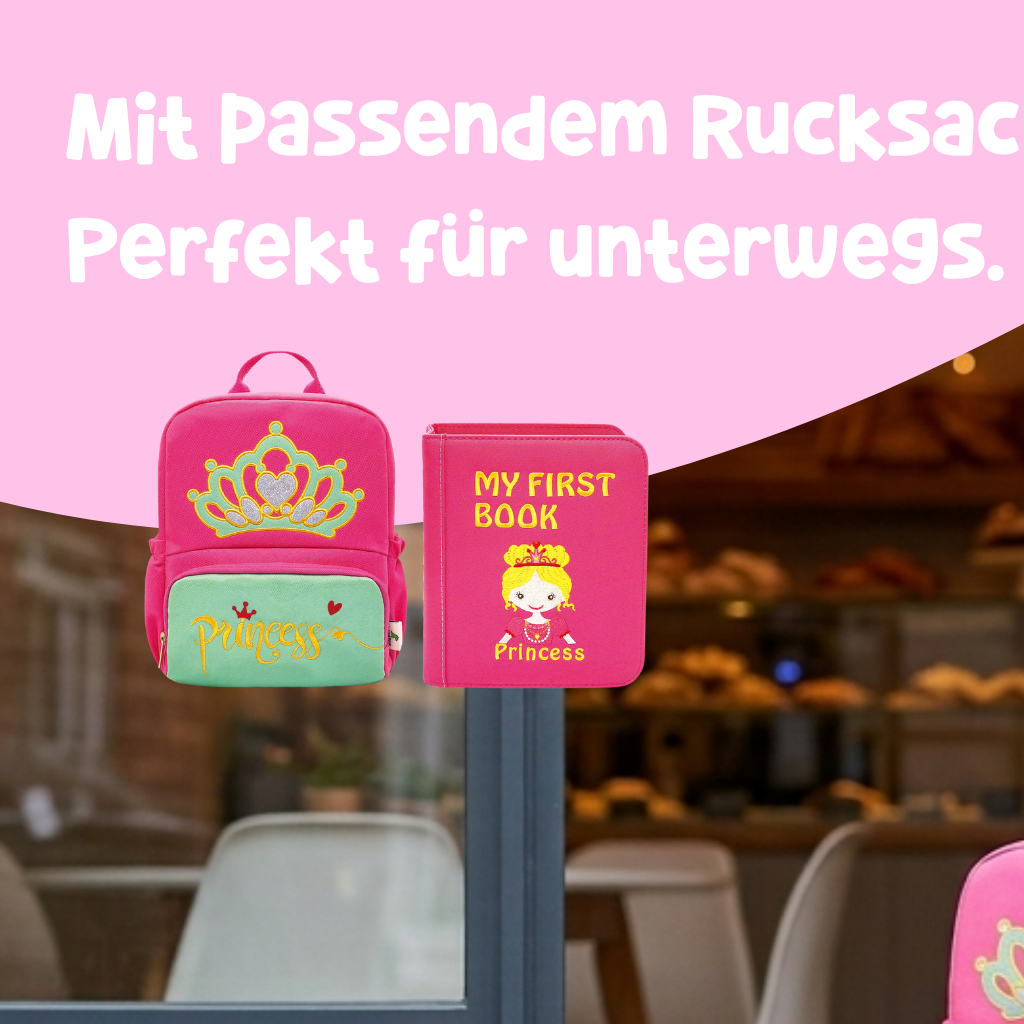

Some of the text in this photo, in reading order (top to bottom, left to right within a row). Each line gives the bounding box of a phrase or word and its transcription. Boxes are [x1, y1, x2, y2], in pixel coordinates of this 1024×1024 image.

[474, 471, 616, 498] MY FIRST
[474, 502, 558, 530] BOOK
[494, 643, 585, 661] Princess
